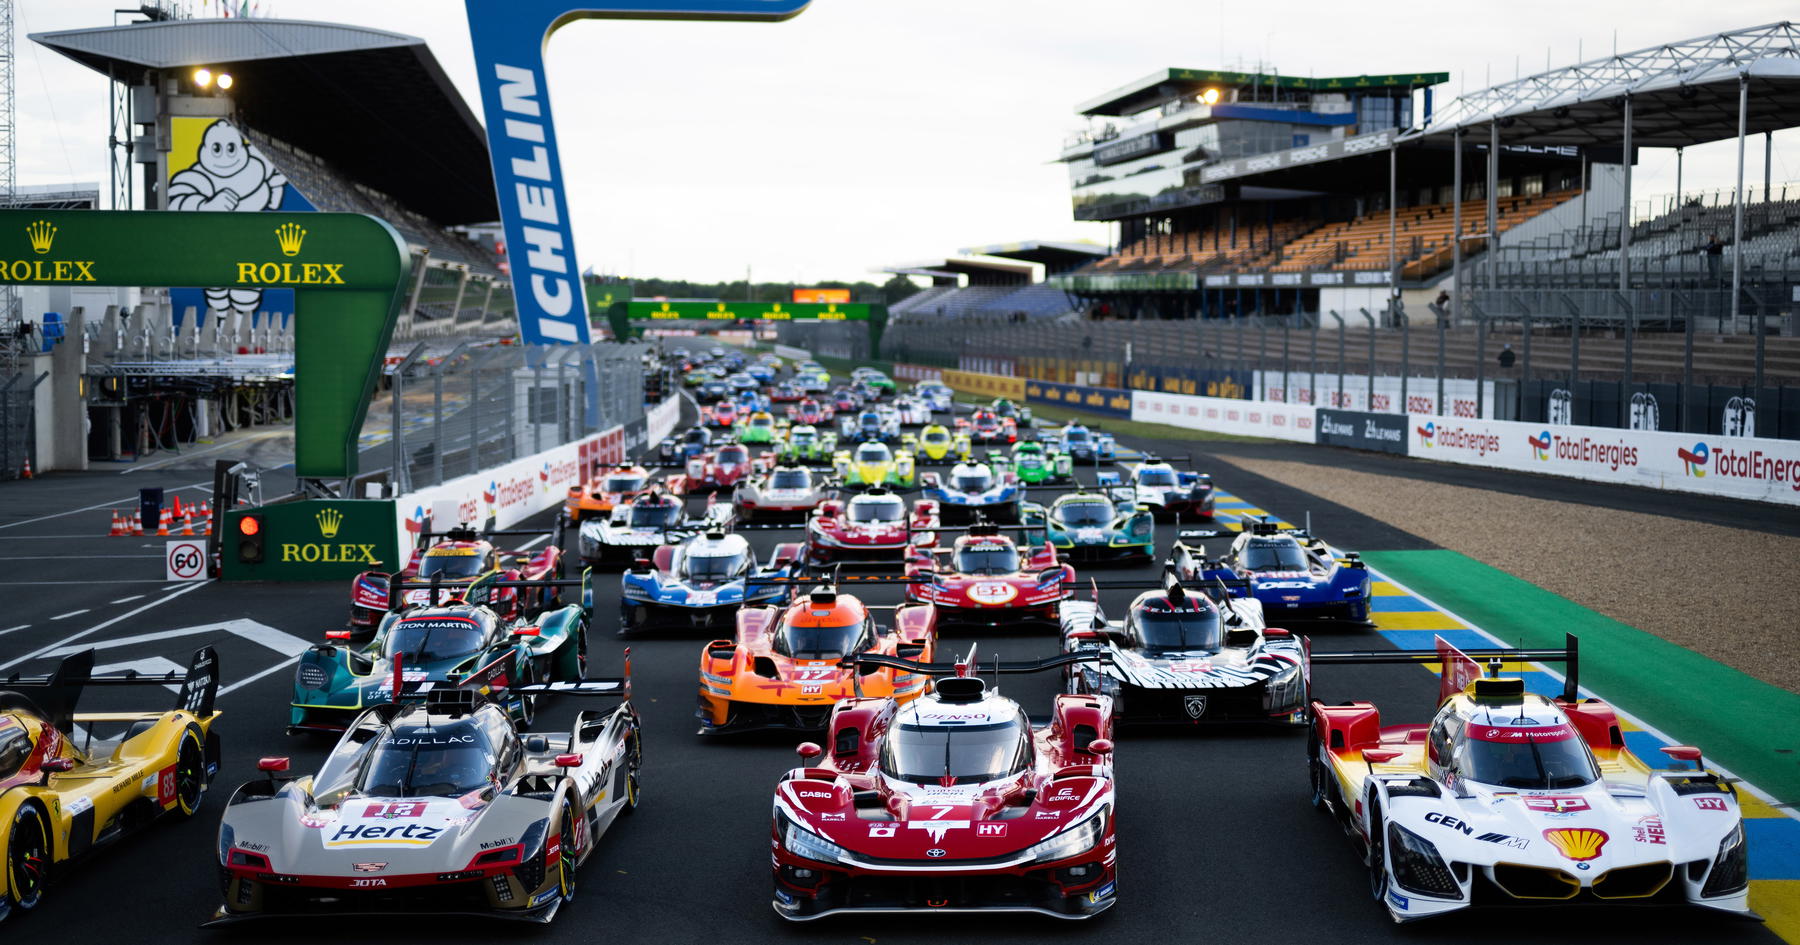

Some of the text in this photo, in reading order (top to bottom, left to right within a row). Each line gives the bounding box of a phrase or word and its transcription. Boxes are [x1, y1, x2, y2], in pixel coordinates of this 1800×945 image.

[494, 63, 578, 347] ICHELIN
[237, 263, 345, 284] ROLEX
[1408, 395, 1432, 414] BOSCH
[1453, 399, 1477, 418] BOSC
[1437, 426, 1499, 456] TotalEnergies
[1554, 435, 1638, 471] TotalEnergies
[174, 552, 199, 571] 60
[282, 544, 377, 563] ROLEX
[1258, 582, 1316, 590] DEX
[428, 622, 473, 630] MARTIN
[800, 671, 831, 680] 17
[1525, 730, 1567, 738] Motorsport
[163, 772, 175, 797] 83
[800, 791, 832, 799] CASIO
[375, 803, 411, 816] 12
[930, 806, 954, 819] 7
[1699, 799, 1725, 810] HY
[331, 824, 443, 841] Hertz
[979, 825, 1005, 835] HY
[1424, 812, 1474, 836] GEN
[1648, 814, 1667, 845] HELIX
[1632, 827, 1647, 842] Shell
[349, 878, 387, 887] JOTA
